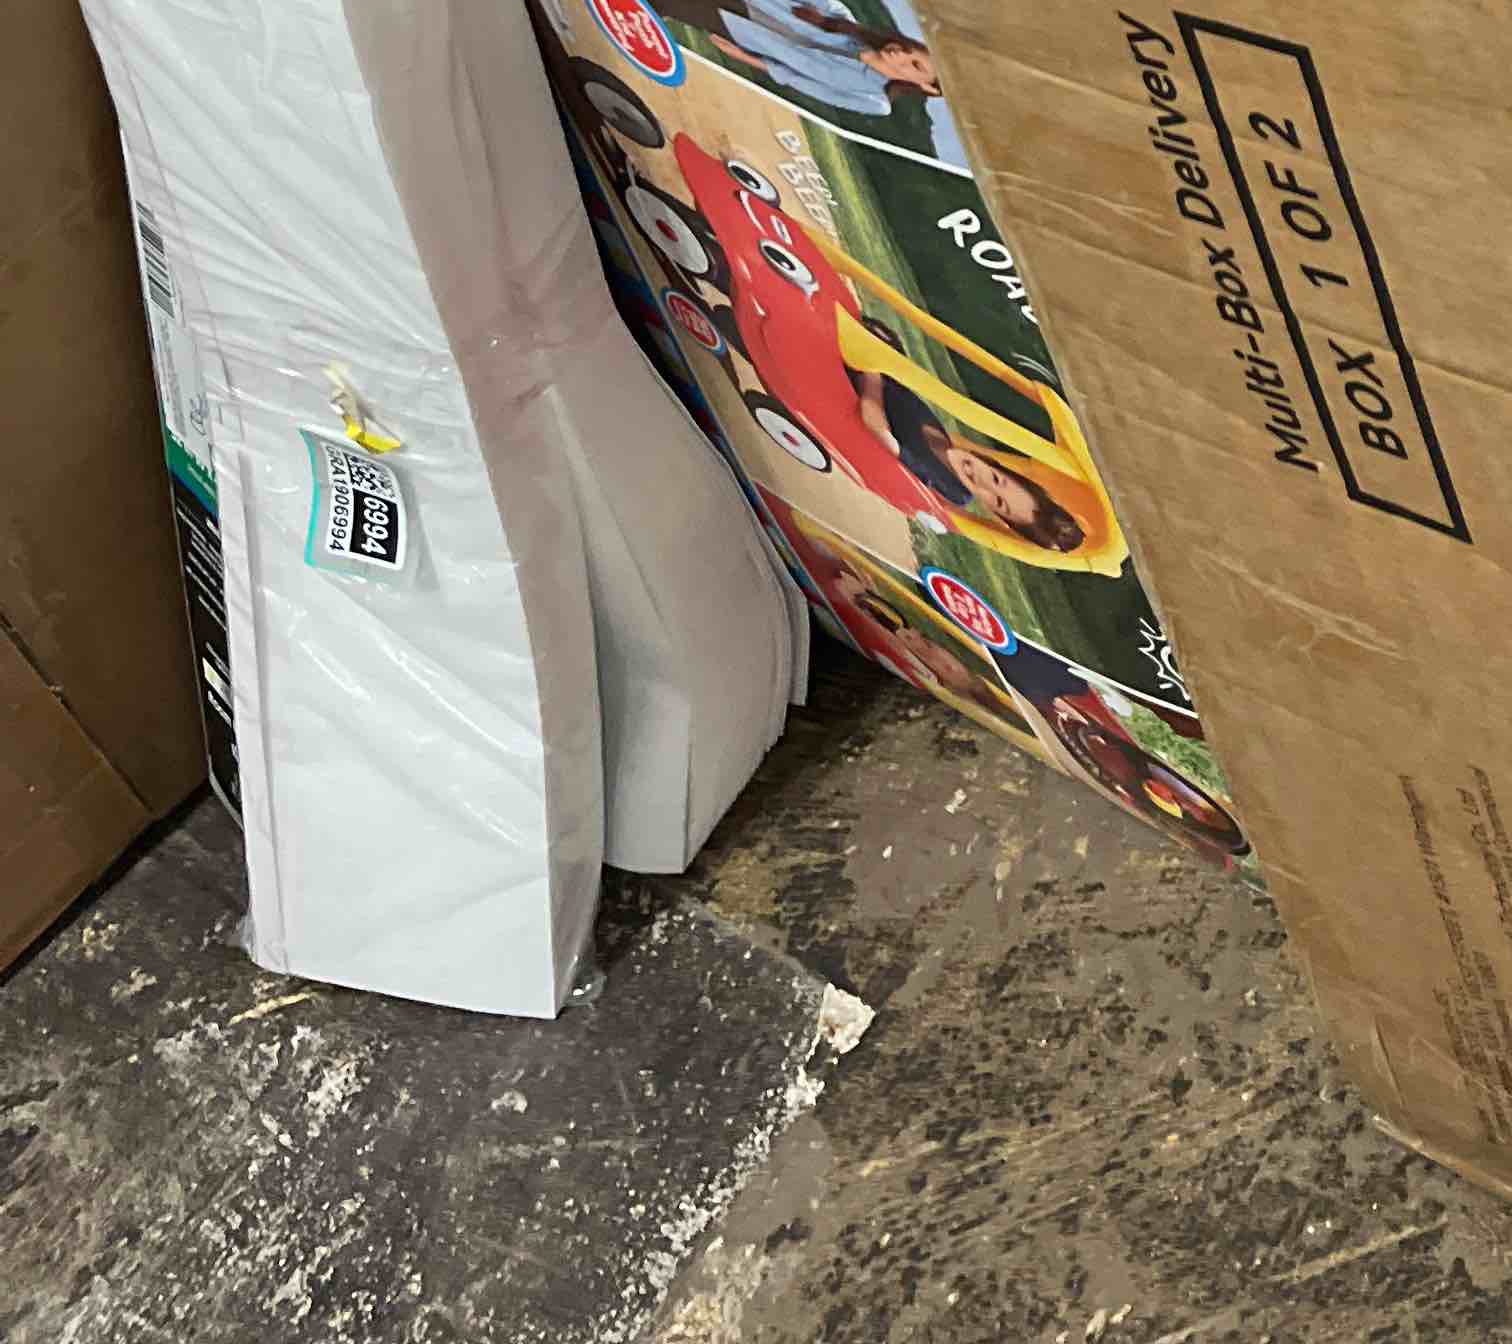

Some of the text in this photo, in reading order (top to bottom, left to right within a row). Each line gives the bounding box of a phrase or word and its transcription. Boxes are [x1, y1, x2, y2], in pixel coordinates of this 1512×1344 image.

[1117, 10, 1321, 473] Multi-Box Delivery
[1248, 111, 1409, 460] BOX 1 OF 2
[325, 445, 351, 552] GRA1906994
[361, 495, 390, 555] 6994
